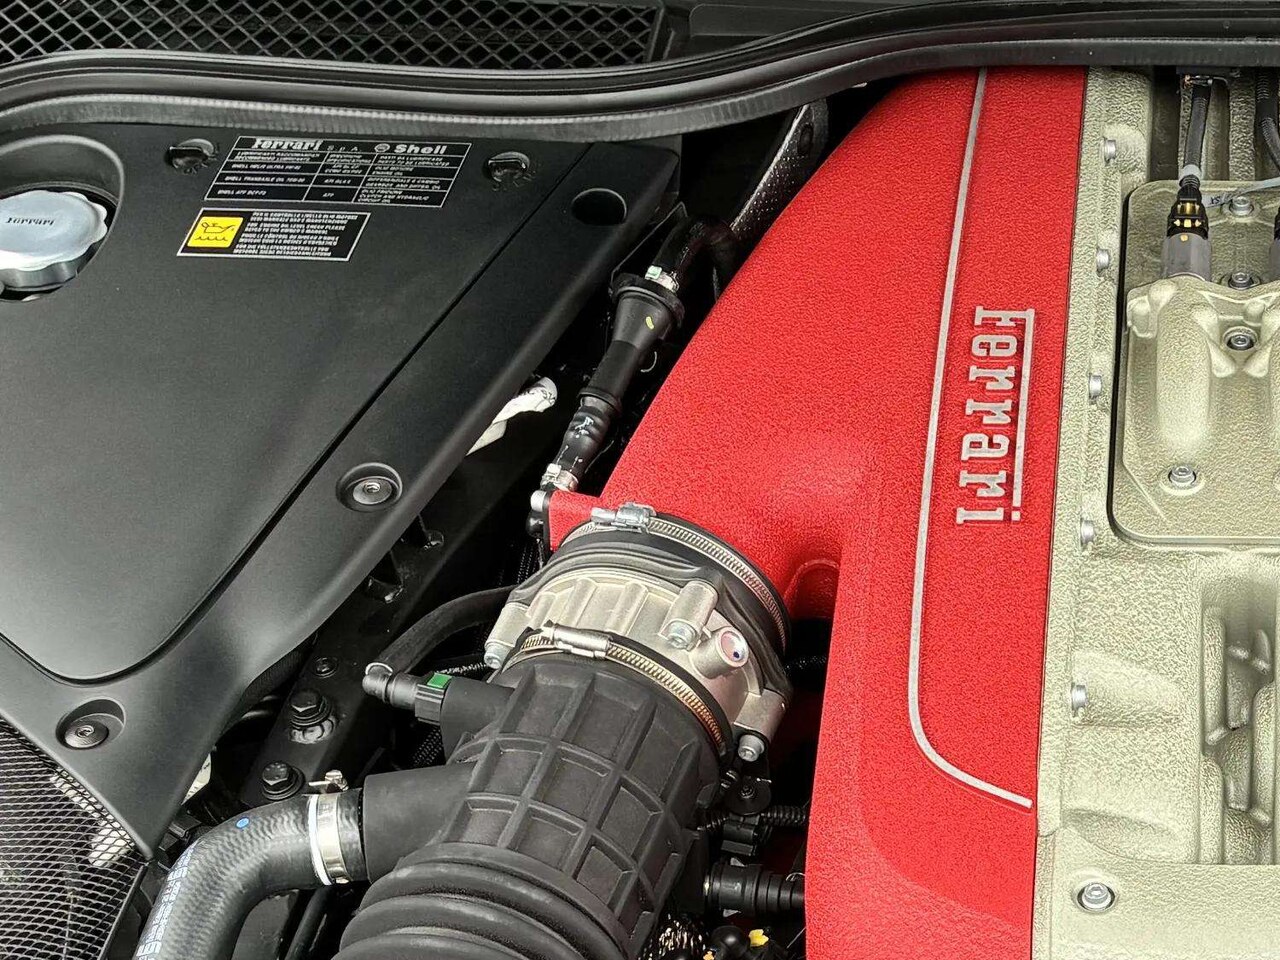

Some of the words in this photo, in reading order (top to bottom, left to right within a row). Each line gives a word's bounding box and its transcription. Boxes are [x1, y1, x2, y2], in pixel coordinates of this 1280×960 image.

[251, 138, 324, 151] Ferrari
[394, 144, 447, 154] Shell
[956, 305, 1036, 525] Ferrari
